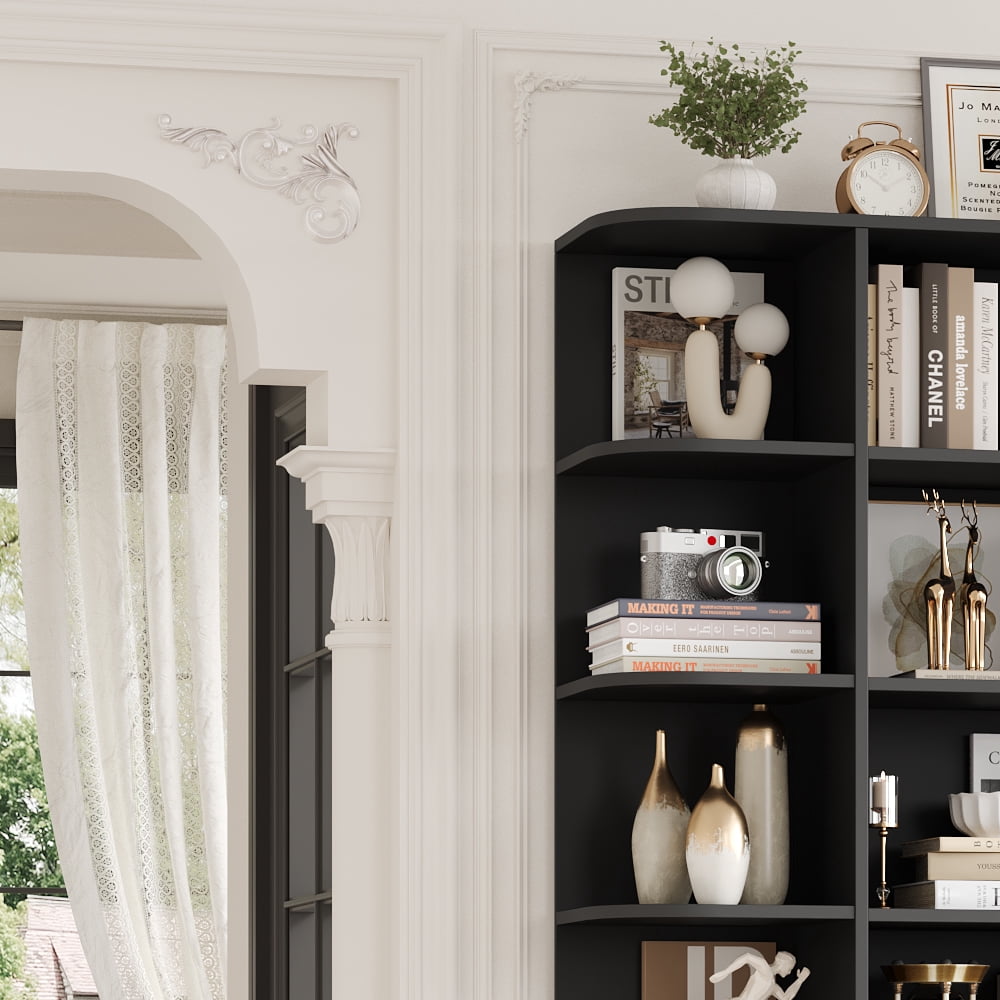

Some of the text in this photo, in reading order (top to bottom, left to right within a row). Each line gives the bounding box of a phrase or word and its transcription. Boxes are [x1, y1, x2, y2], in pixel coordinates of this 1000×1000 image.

[880, 280, 901, 375] The body beyond
[982, 297, 994, 324] Karen
[932, 326, 938, 334] OF
[955, 315, 969, 410] amanda lovelace
[978, 326, 994, 375] McCartney
[928, 350, 943, 428] CHANEL
[627, 602, 679, 616] MAKING
[681, 603, 695, 616] IT
[673, 644, 729, 654] EERO SAARINEN
